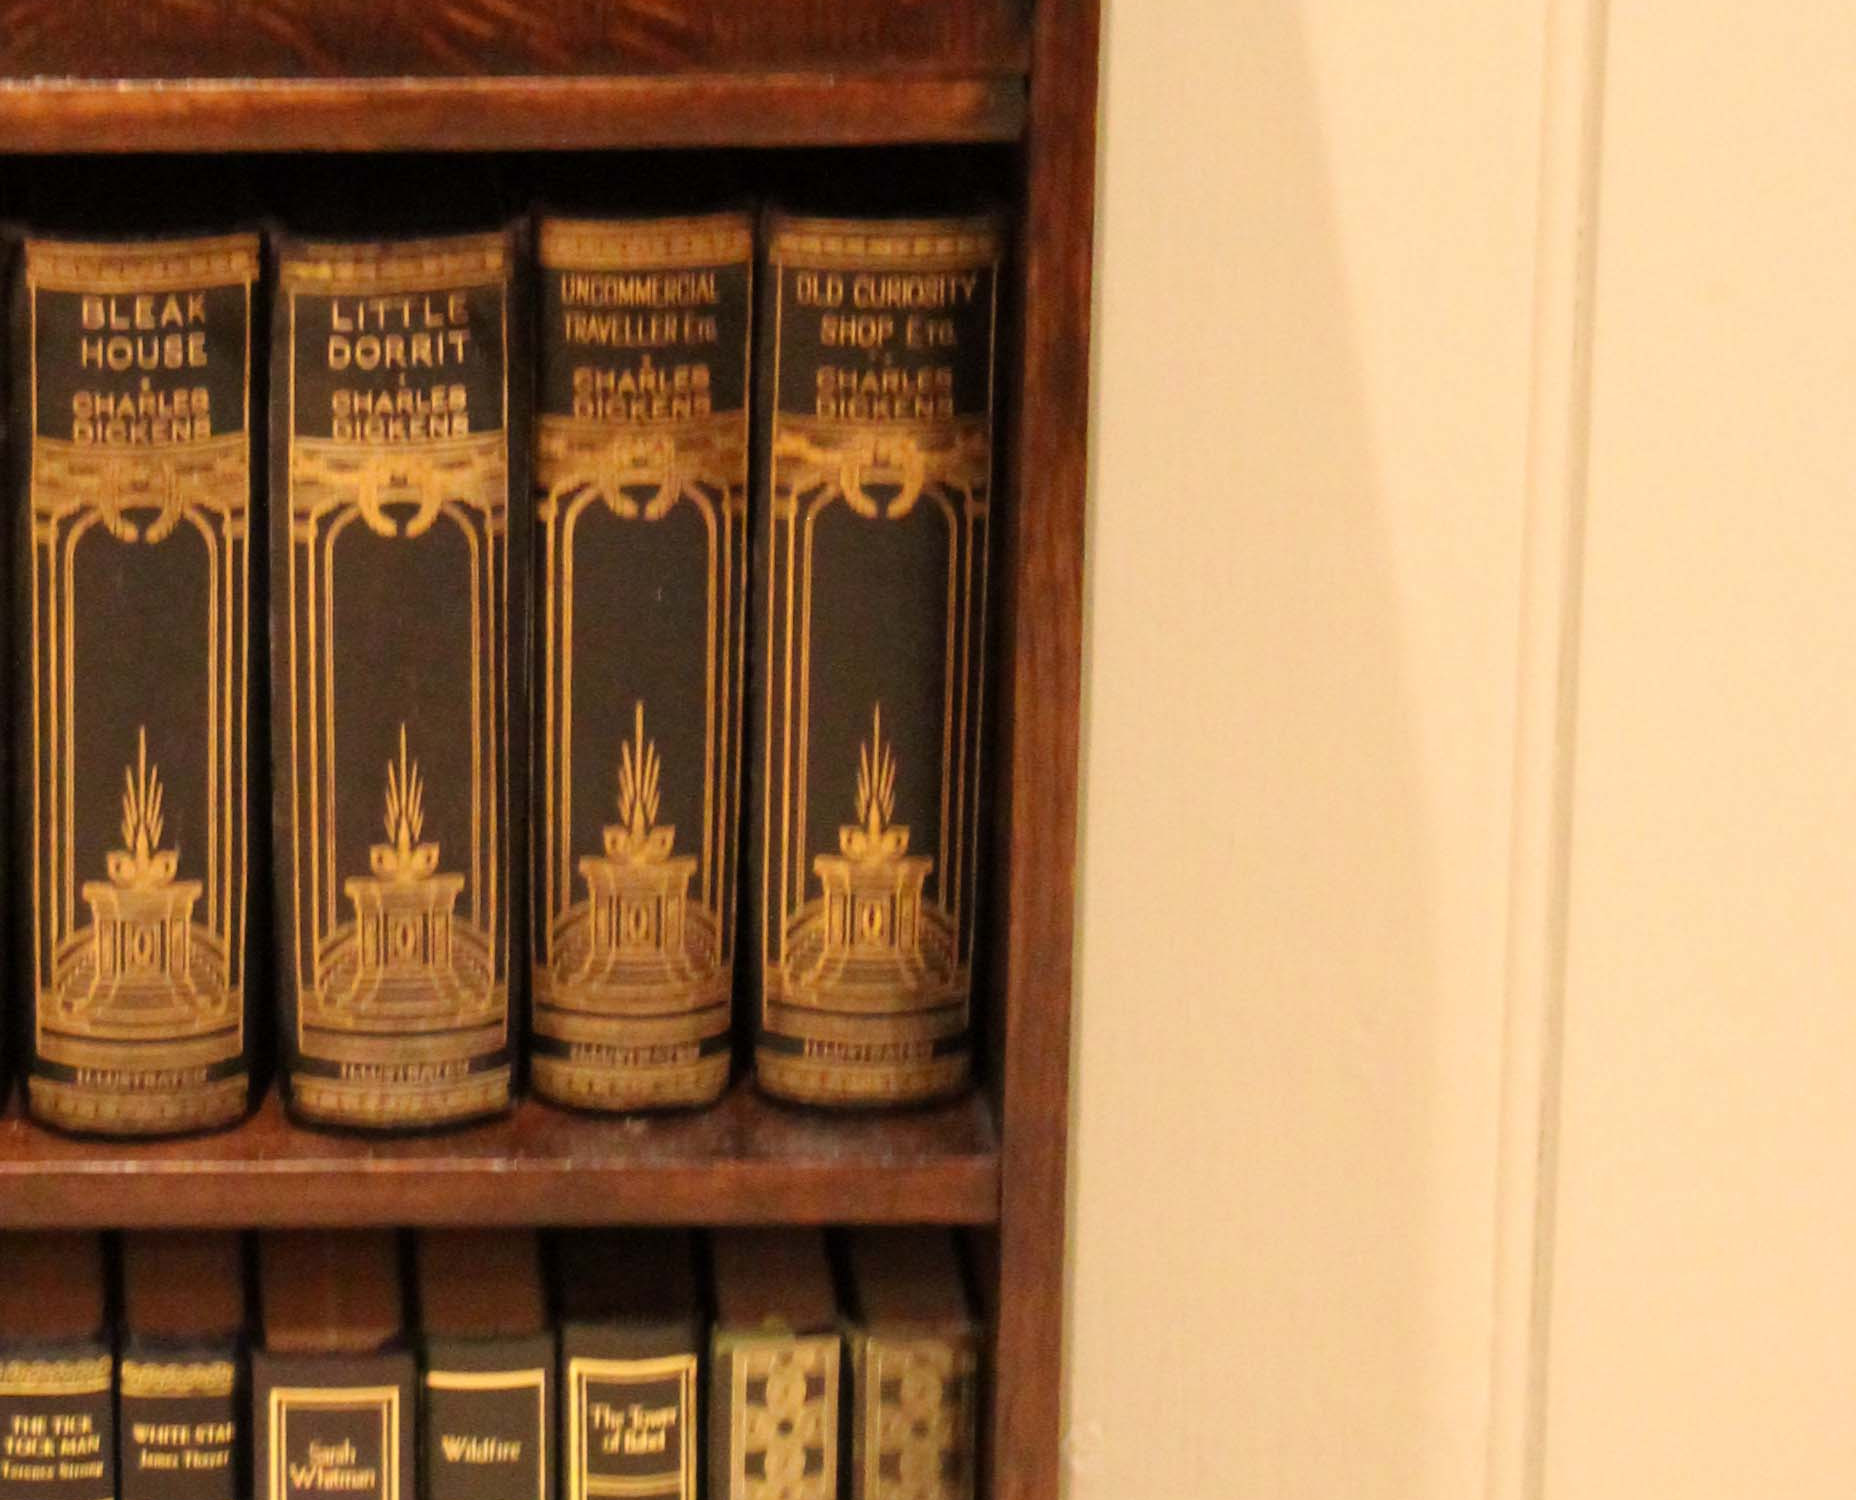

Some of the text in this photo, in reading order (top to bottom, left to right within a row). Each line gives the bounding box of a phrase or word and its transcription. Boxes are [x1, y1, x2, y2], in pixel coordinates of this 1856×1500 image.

[797, 273, 843, 303] OLD
[82, 295, 207, 330] BLEAK
[332, 296, 470, 332] LITTLE
[820, 314, 893, 346] SHOP
[82, 331, 208, 370] HOUSE
[328, 331, 470, 370] DORRIT
[573, 363, 710, 394] CHARLES
[815, 364, 953, 396] CHARLES
[72, 390, 210, 419] CHARLES
[332, 385, 467, 417] CHARLES
[573, 393, 712, 419] DICKENS
[815, 394, 955, 419] DICKENS
[72, 418, 211, 446] DICKENS
[332, 416, 470, 444] DICKENS
